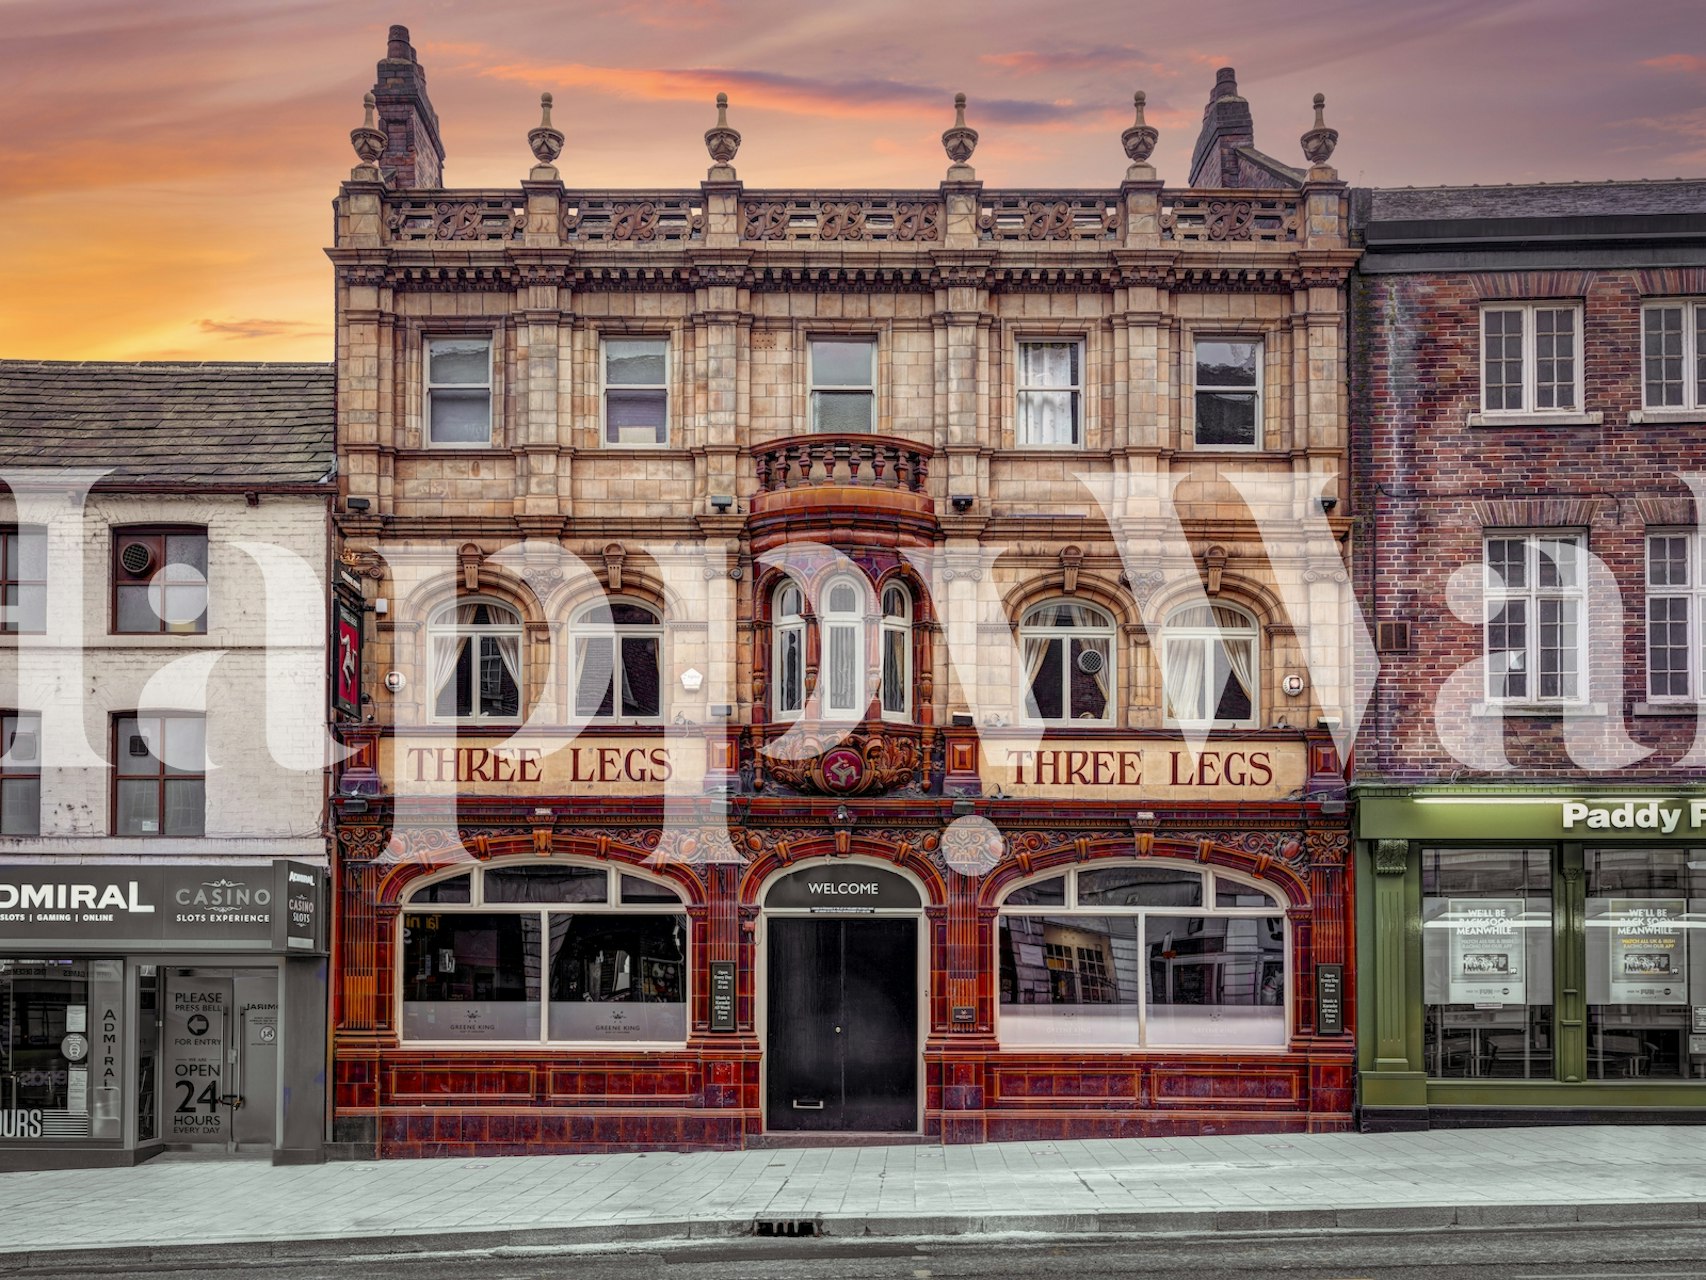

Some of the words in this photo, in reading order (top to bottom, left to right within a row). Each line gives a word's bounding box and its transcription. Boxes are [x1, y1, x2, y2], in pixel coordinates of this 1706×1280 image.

[407, 748, 543, 782] THREE
[570, 748, 673, 782] LEGS
[1007, 750, 1142, 785] THREE
[1169, 751, 1273, 786] LEGS
[1563, 802, 1682, 833] Paddy
[808, 882, 879, 895] WELCOME
[175, 888, 271, 906] CASINO
[288, 899, 314, 913] CASINO
[0, 913, 25, 922] SLOTS
[36, 913, 71, 922] GAMING
[82, 913, 114, 922] ONLINE
[176, 914, 206, 922] SLOTS
[209, 914, 270, 922] EXPERIENCE
[1467, 909, 1493, 917] WE'LL
[1495, 909, 1506, 917] BE
[1629, 909, 1655, 917] WE'LL
[1656, 909, 1667, 917] BE
[175, 992, 222, 1003] PLEASE
[175, 1004, 199, 1012] PRESS
[202, 1004, 222, 1012] BELL
[103, 1009, 116, 1090] ADMIRAL
[175, 1064, 220, 1076] OPEN
[175, 1080, 218, 1113] 24
[0, 1109, 42, 1137] URS
[174, 1115, 220, 1125] HOURS
